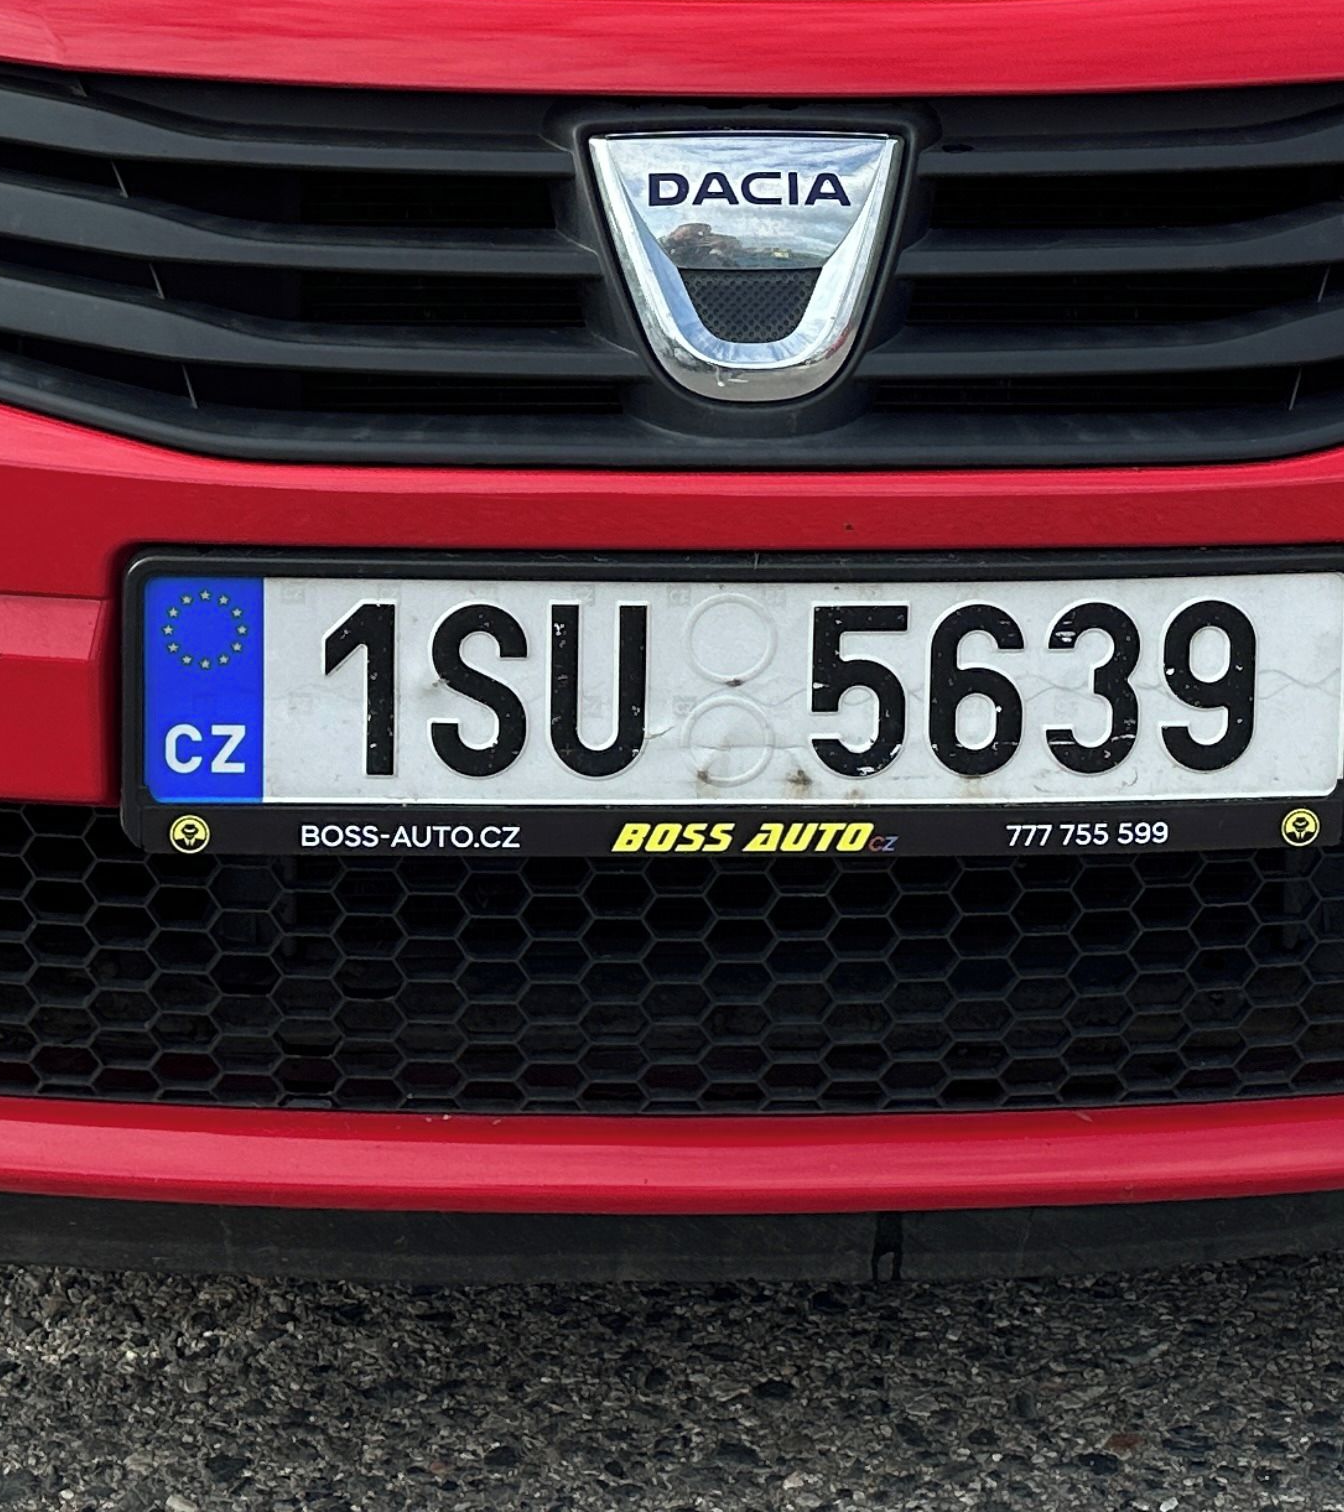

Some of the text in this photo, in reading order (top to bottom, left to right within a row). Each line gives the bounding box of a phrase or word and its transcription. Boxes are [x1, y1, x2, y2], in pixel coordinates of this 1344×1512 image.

[648, 171, 851, 206] DACIA
[324, 600, 1257, 780] 1SU 5639
[165, 723, 246, 774] CZ
[301, 824, 521, 849] BOSS-AUTO.CZ
[611, 823, 734, 853] BOSS
[743, 822, 874, 852] AUTO
[1006, 821, 1169, 847] 777 755 599
